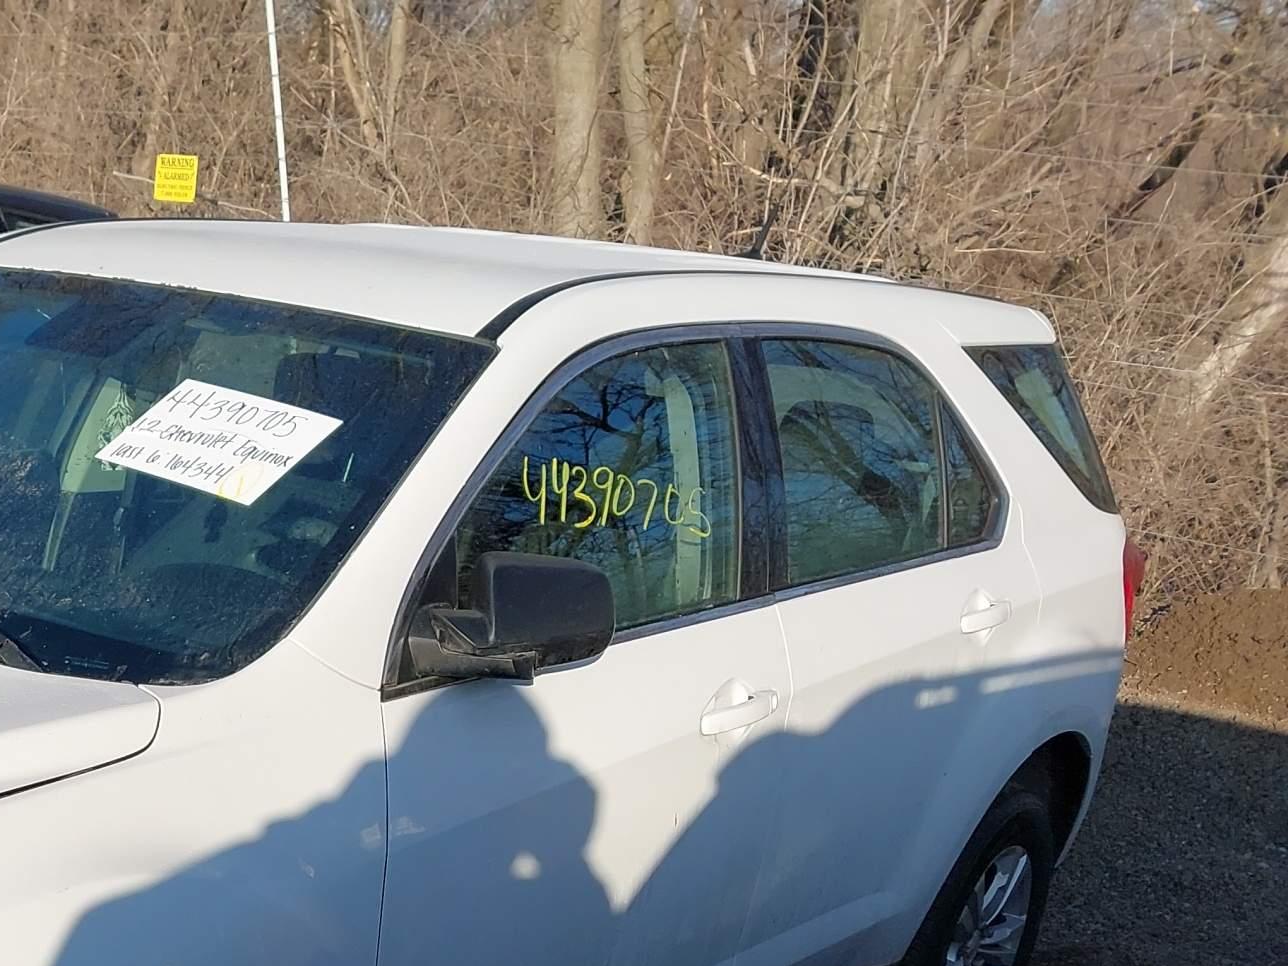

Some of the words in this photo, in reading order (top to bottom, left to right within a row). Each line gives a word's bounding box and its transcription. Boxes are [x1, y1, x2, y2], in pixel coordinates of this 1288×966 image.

[160, 156, 195, 168] WARNING
[165, 388, 309, 438] 44390705
[164, 453, 235, 485] 164344
[232, 438, 294, 468] Equinox
[522, 455, 711, 538] 44390705
